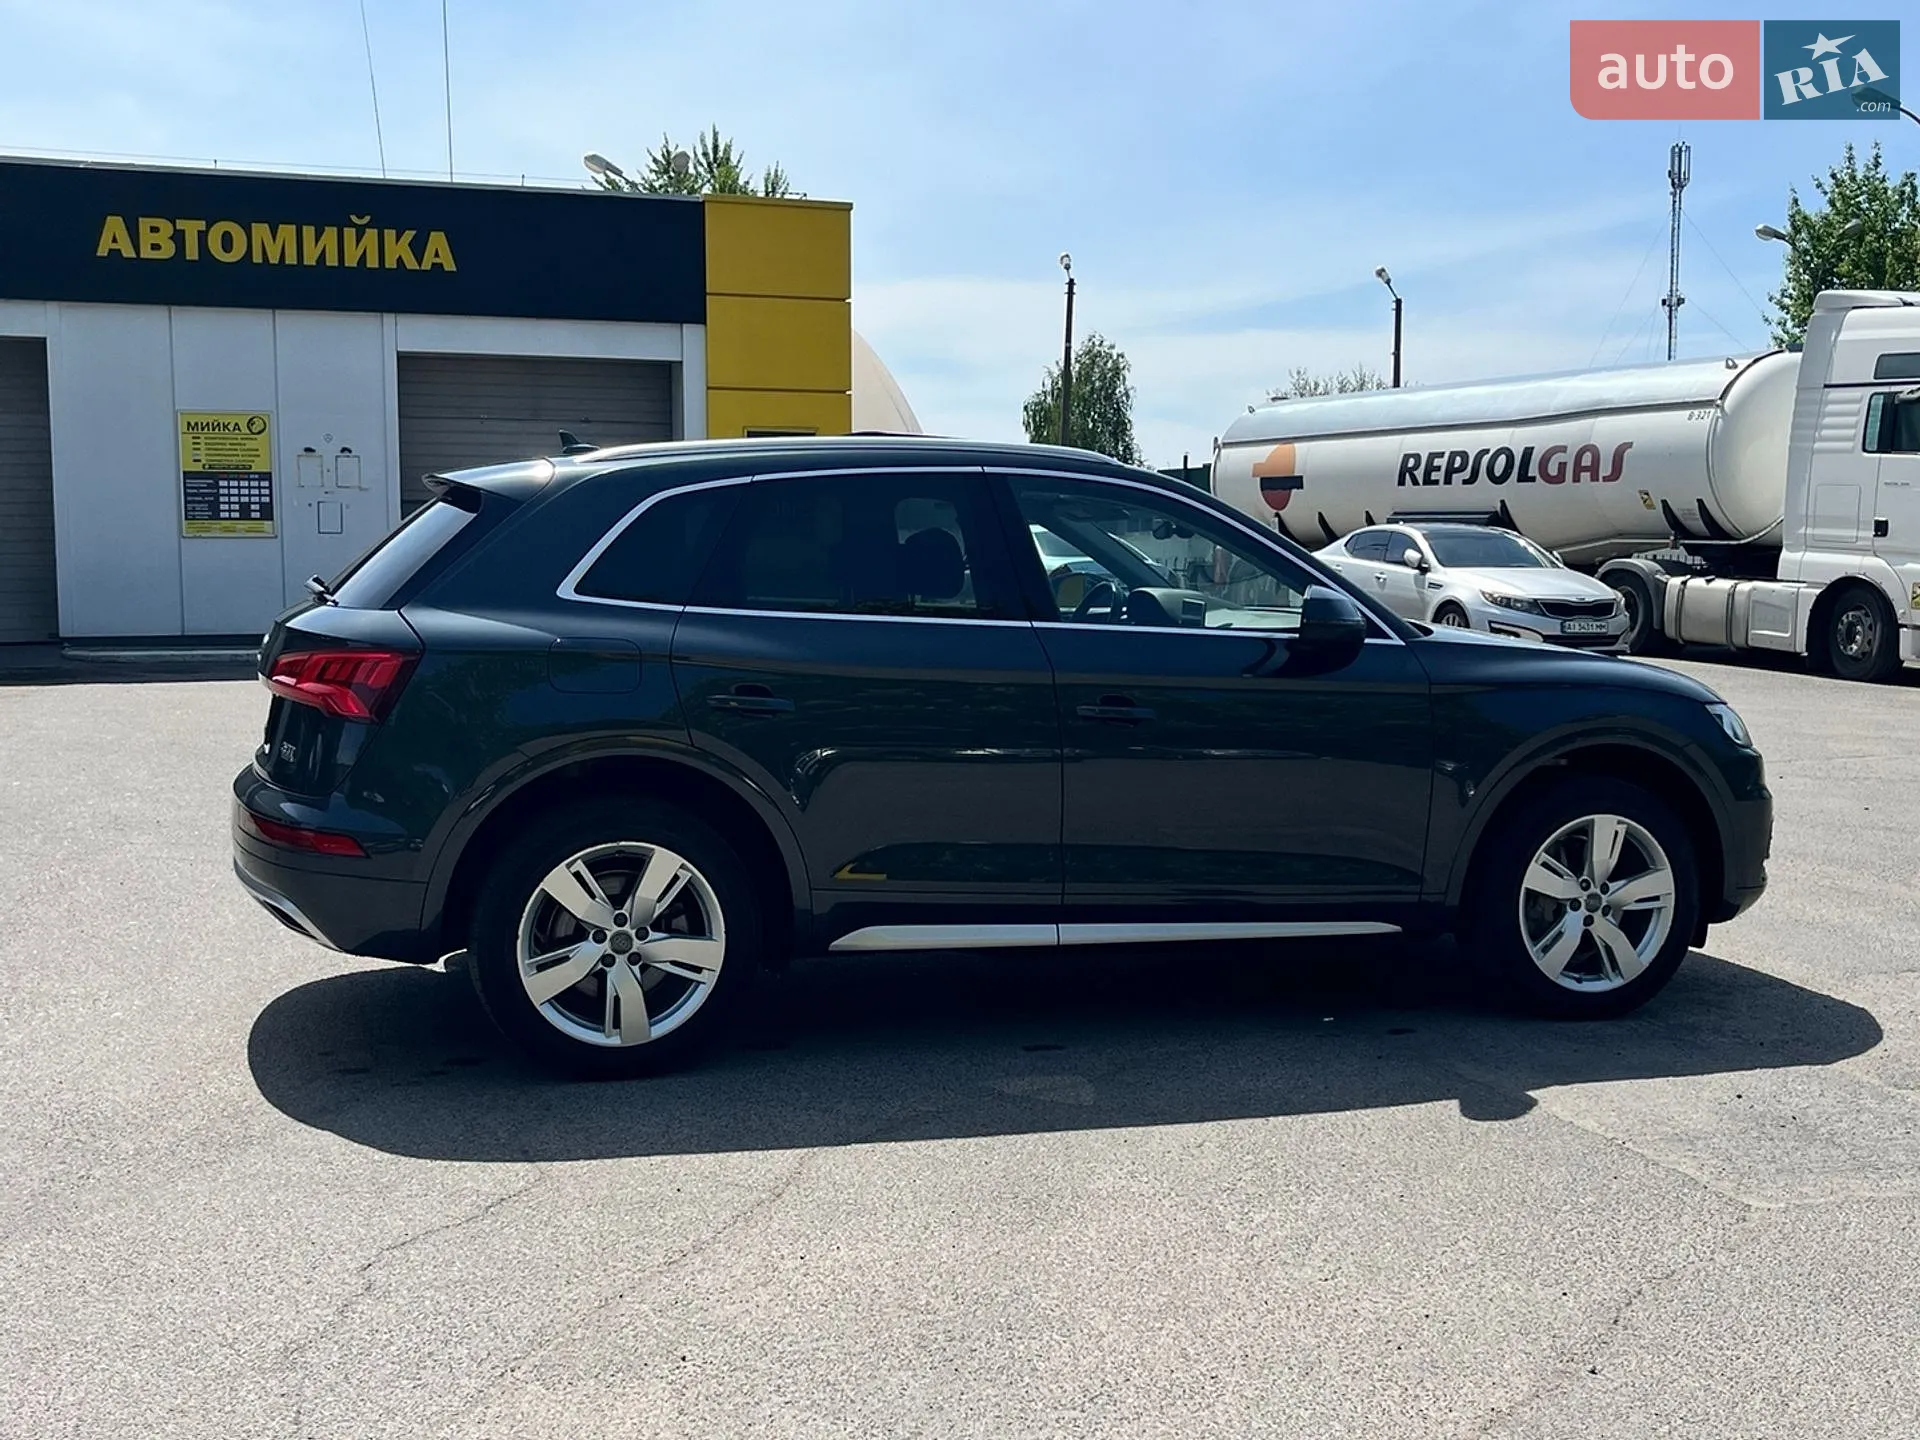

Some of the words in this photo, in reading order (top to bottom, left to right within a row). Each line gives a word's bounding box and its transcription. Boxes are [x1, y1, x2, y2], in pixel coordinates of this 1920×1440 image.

[96, 214, 457, 272] АВТОМИЙКА
[187, 418, 242, 433] МИЙКА
[1397, 441, 1634, 487] REPSOLGAS
